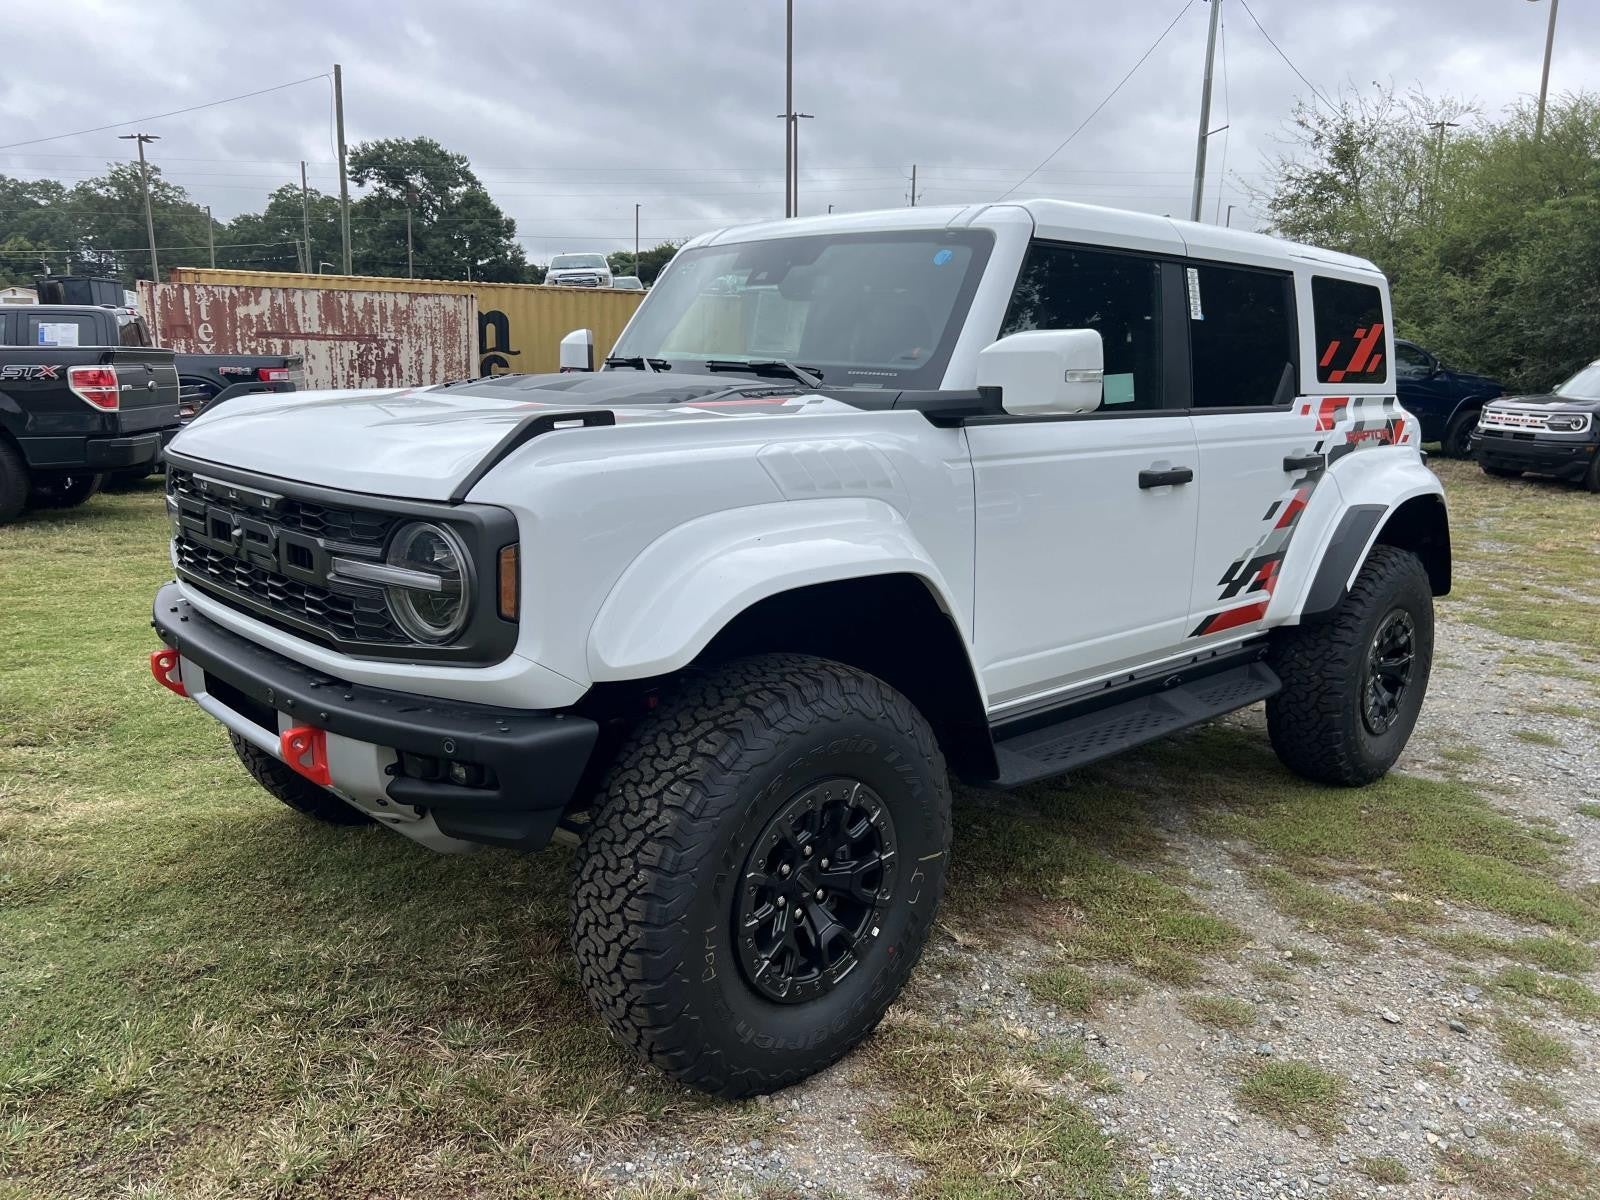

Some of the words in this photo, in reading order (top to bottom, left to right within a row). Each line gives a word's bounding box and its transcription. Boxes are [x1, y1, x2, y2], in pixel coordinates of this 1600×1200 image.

[1, 364, 62, 378] STX
[1345, 428, 1391, 443] RAPTOR
[176, 494, 326, 589] FORD
